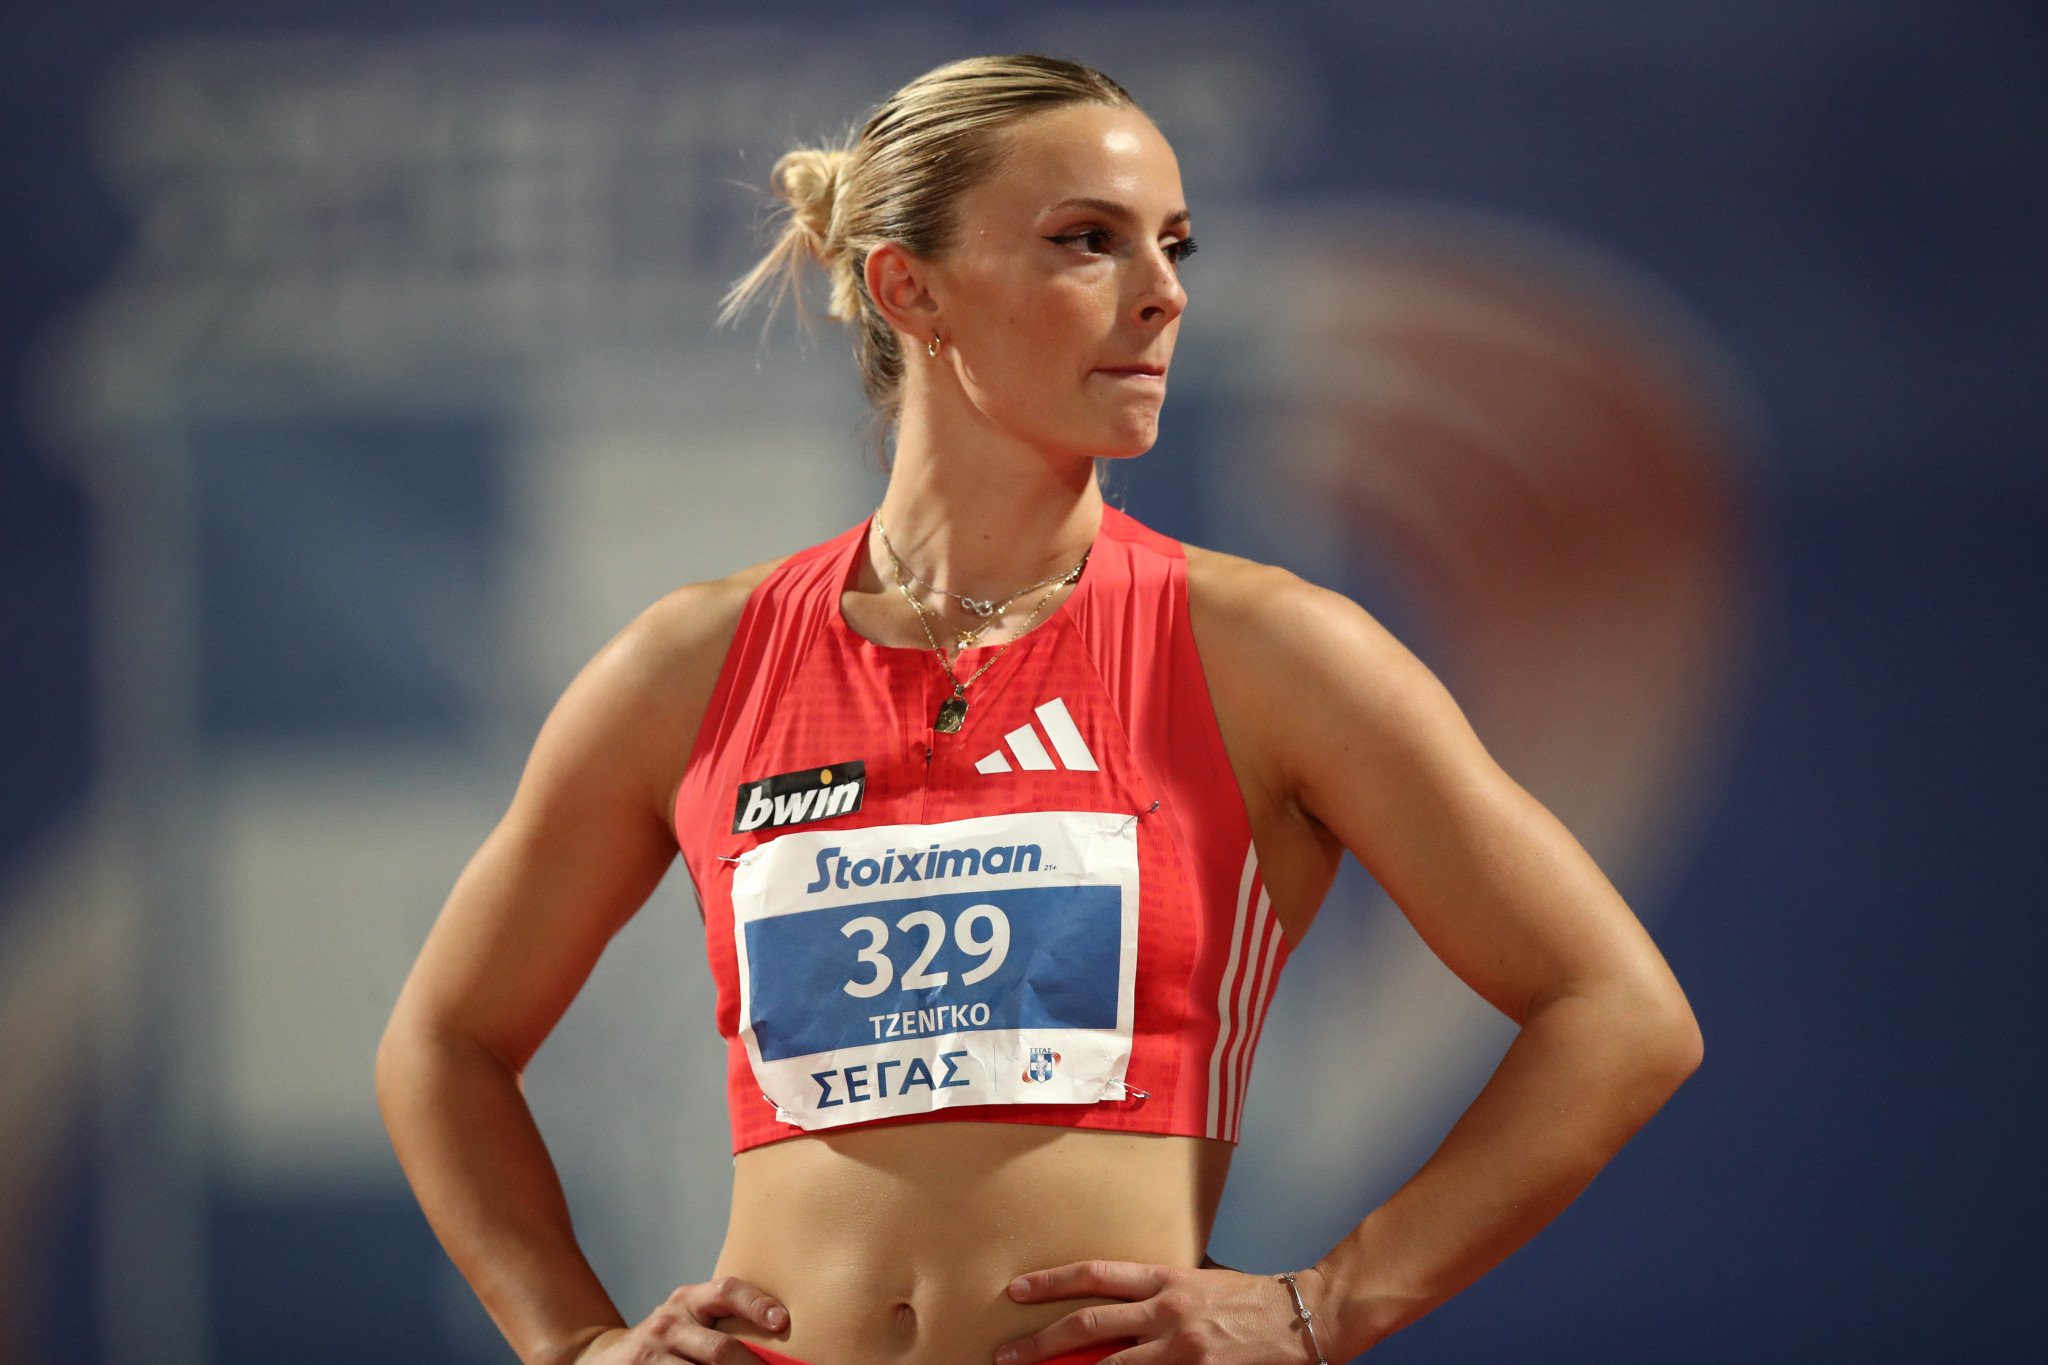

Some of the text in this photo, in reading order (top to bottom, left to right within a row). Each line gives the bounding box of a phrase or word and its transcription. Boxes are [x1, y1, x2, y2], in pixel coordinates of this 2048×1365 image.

[738, 768, 861, 831] bwin
[807, 843, 1042, 894] Stoiximan
[840, 904, 1011, 999] 329
[869, 1003, 991, 1039] ΤΖΕΝΓΚΟ
[811, 1051, 970, 1109] ΣΕΓΑΣ
